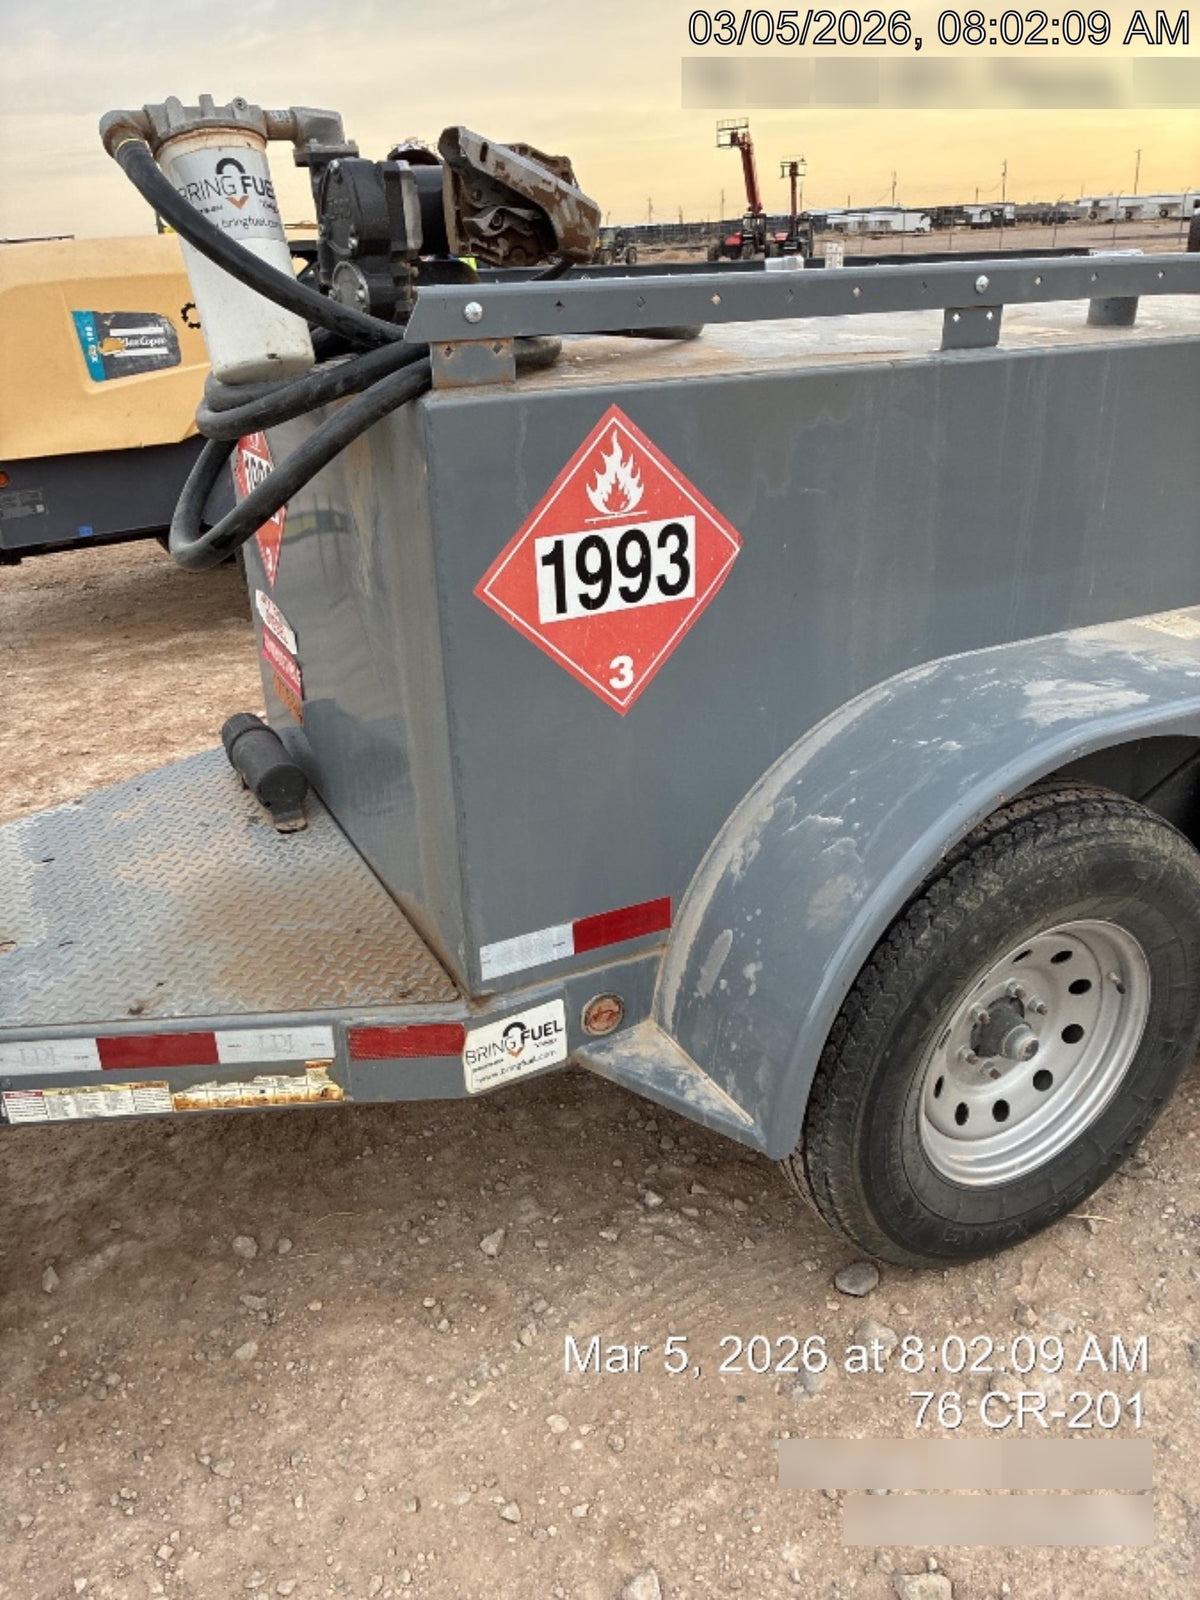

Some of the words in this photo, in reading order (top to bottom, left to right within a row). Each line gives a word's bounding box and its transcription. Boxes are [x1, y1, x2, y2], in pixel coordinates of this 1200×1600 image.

[240, 175, 276, 201] FUE
[541, 522, 691, 614] 1993
[608, 655, 634, 689] 3
[465, 1036, 517, 1064] BRING
[521, 1020, 564, 1046] FUEL
